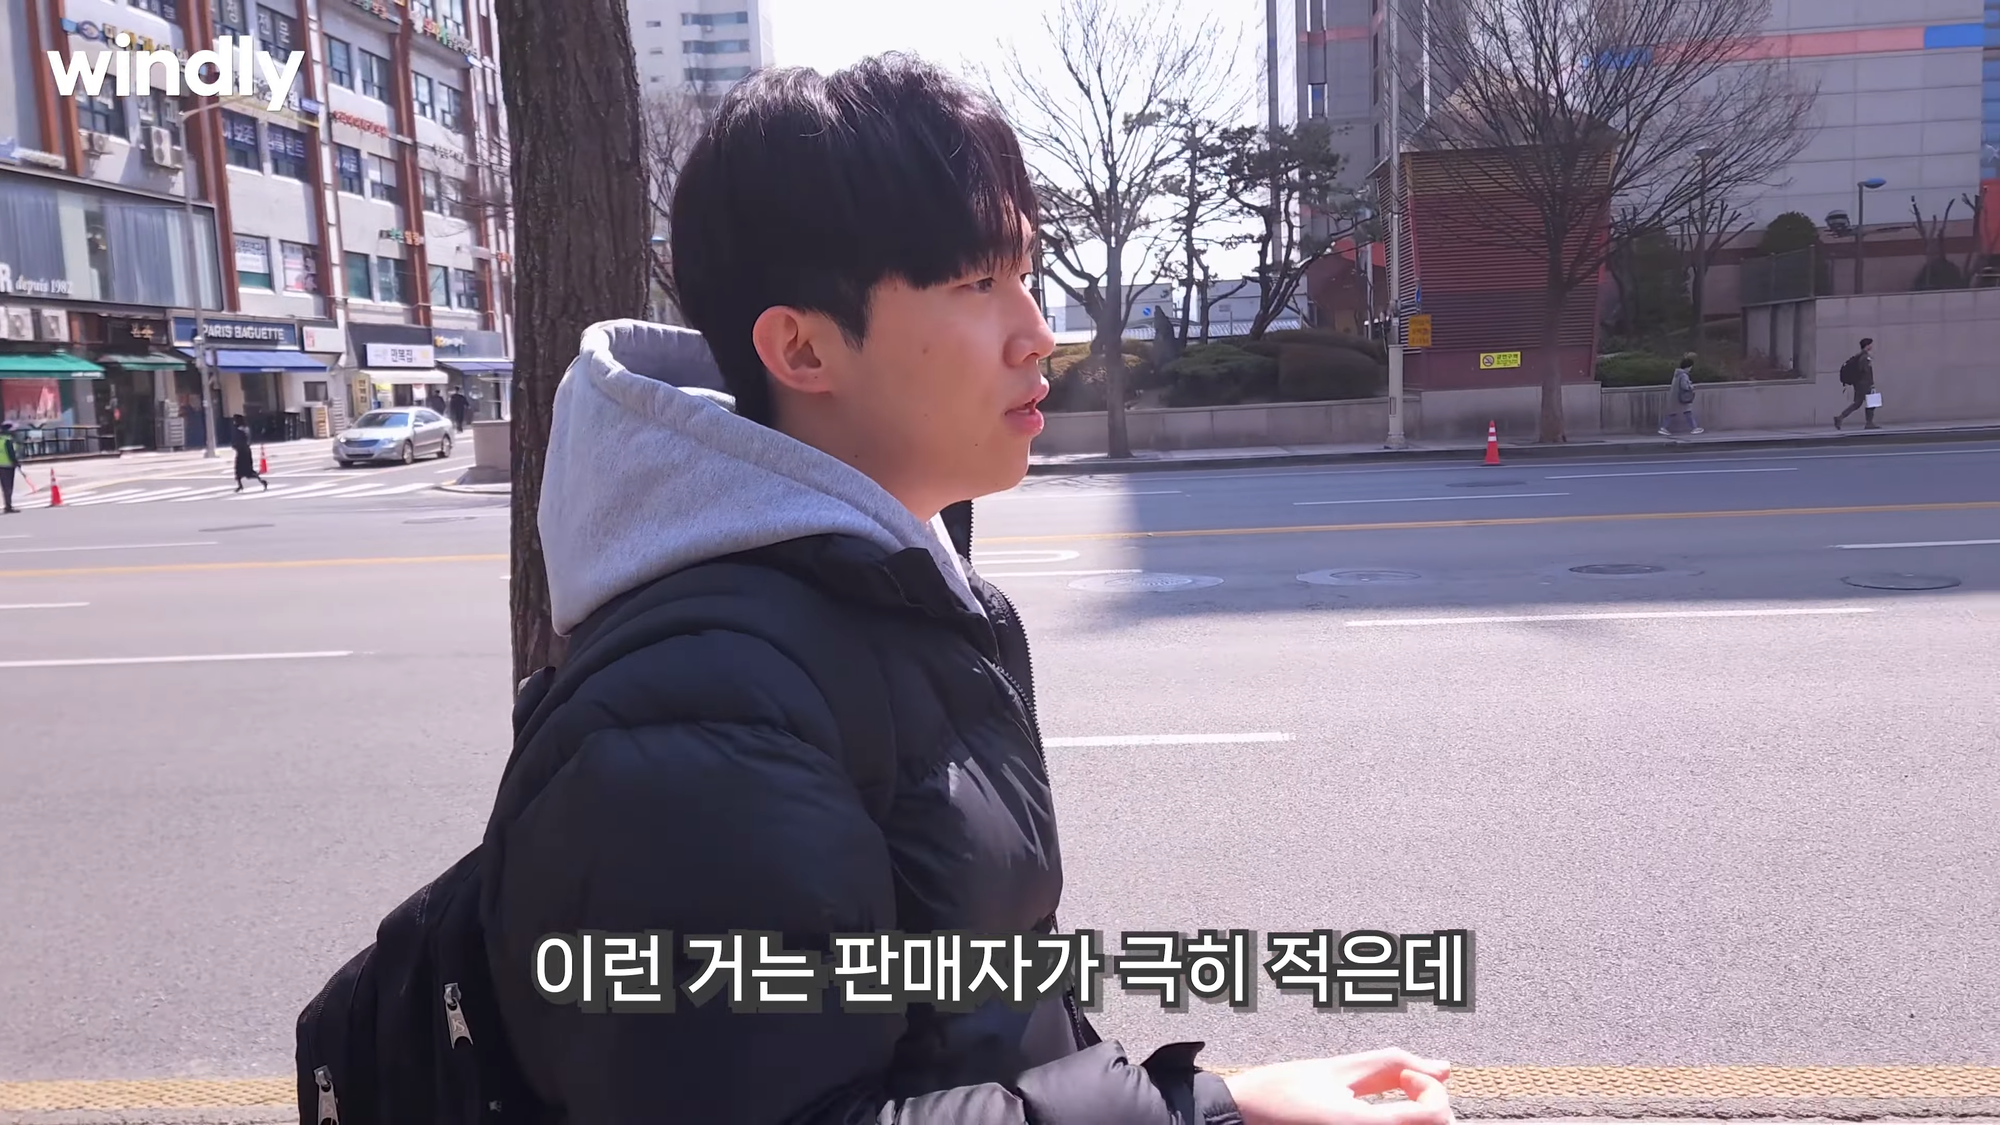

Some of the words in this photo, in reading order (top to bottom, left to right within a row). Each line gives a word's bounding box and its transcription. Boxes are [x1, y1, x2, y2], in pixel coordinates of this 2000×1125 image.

[15, 274, 49, 295] depuis
[50, 279, 74, 294] 1982
[203, 324, 233, 339] PARIS
[234, 325, 285, 341] BAGUETTE
